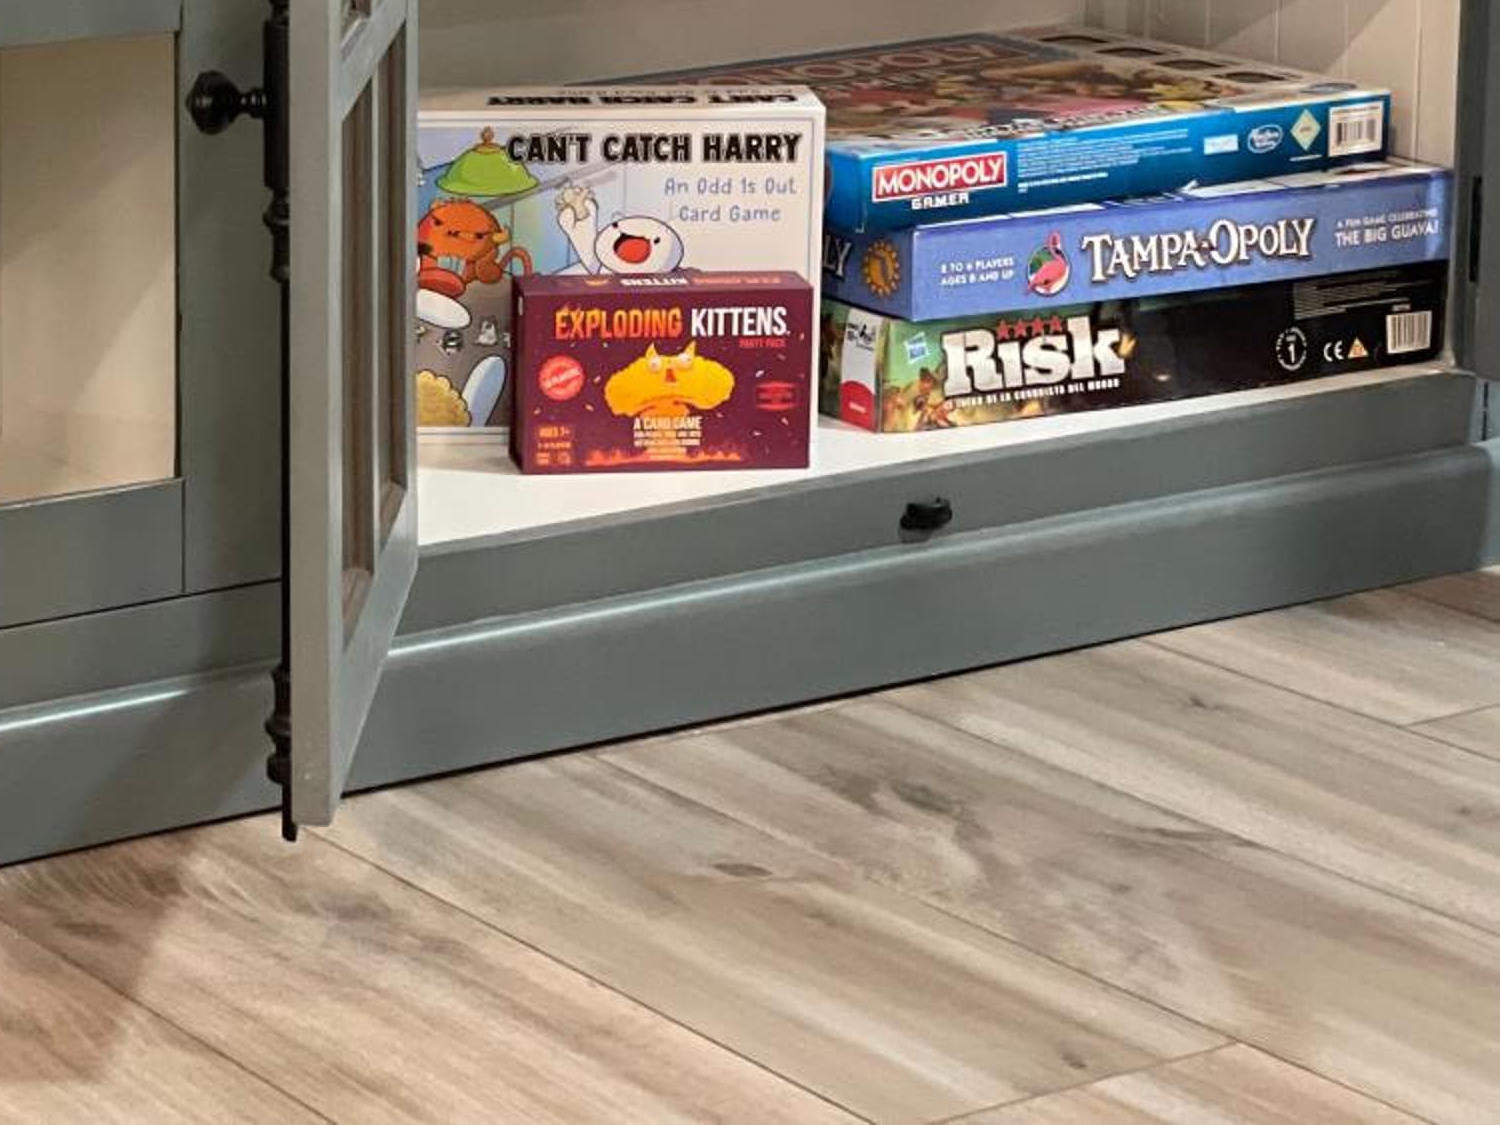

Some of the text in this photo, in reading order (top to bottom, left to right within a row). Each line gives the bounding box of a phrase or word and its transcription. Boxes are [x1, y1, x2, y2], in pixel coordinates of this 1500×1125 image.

[507, 133, 802, 162] CAN'T CATCH HARRY
[664, 177, 689, 195] An
[697, 177, 732, 194] Odd
[765, 177, 797, 194] Out
[878, 158, 1002, 196] MONOPOLY
[911, 192, 970, 210] GAMER
[679, 204, 782, 222] Card Game
[1334, 230, 1360, 248] THE
[1364, 227, 1387, 244] BIG
[975, 257, 1014, 271] PLAYERS
[555, 306, 683, 340] EXPLODING
